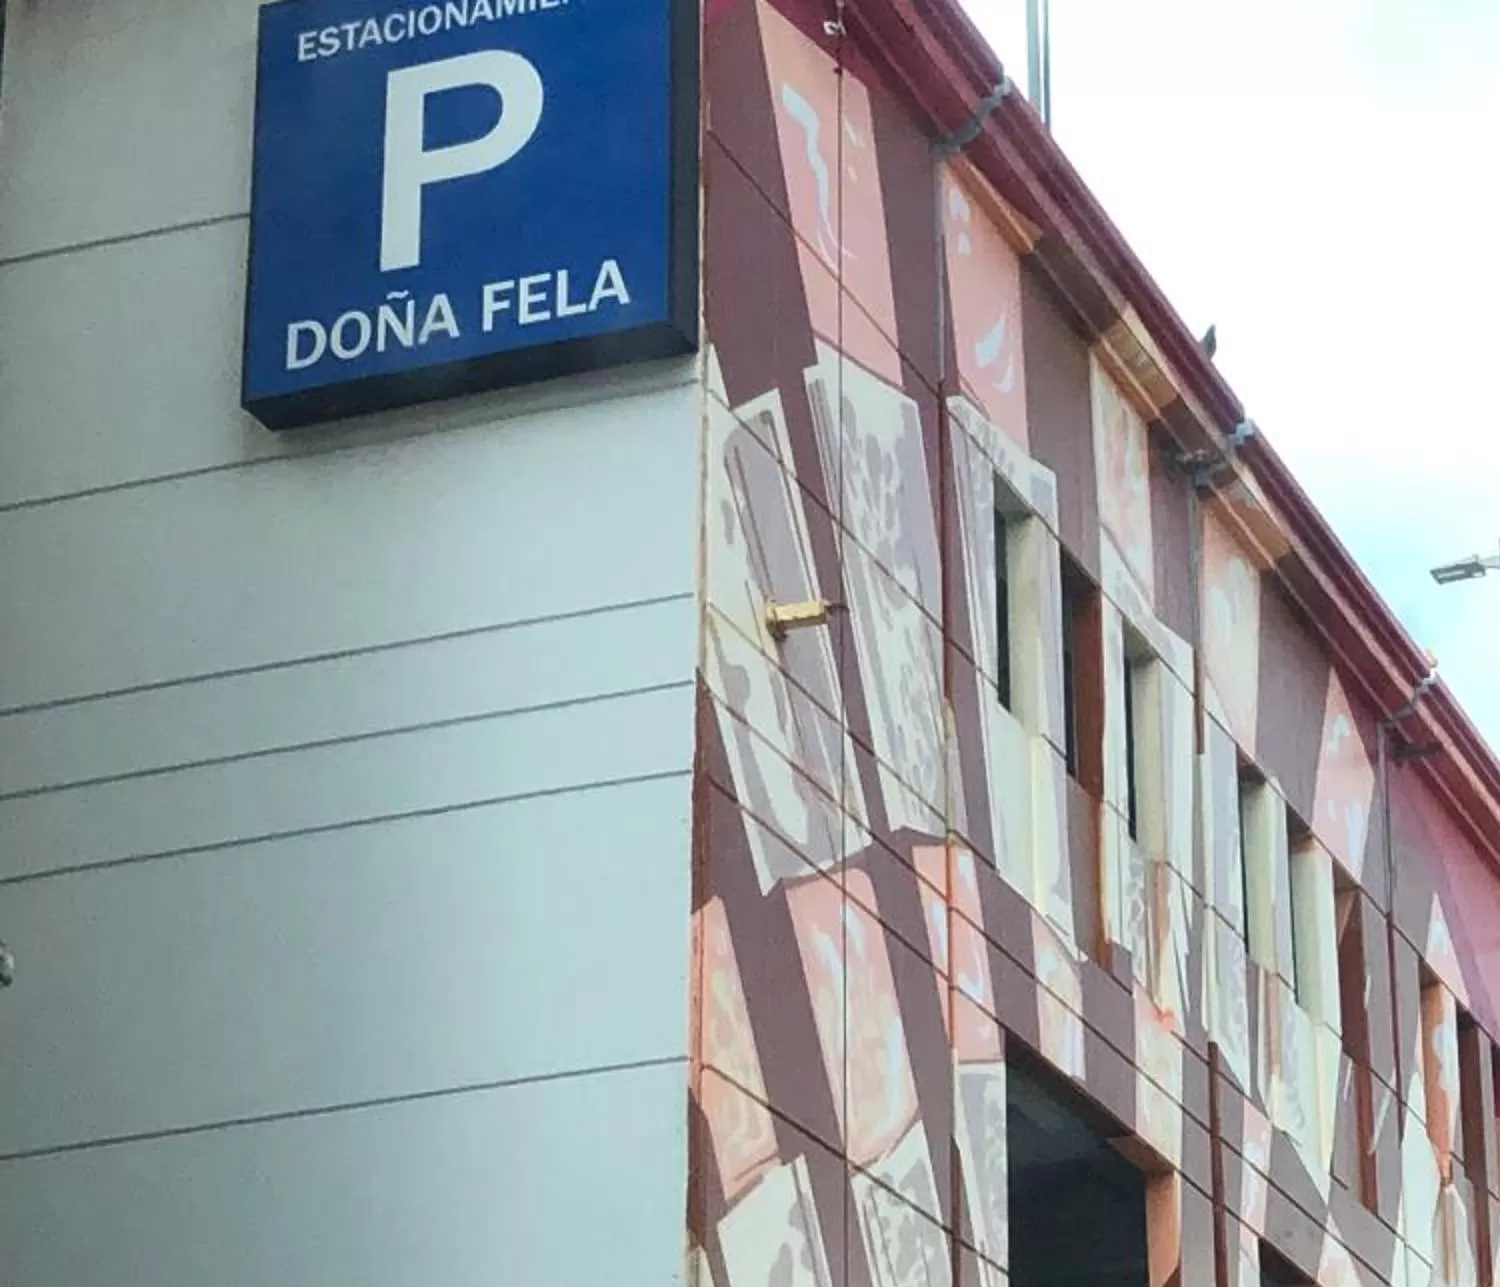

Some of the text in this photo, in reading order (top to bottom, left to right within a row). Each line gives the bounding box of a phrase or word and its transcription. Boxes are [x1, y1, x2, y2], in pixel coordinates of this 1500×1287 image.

[380, 49, 545, 272] P
[286, 259, 630, 371] DOÑA FELA
